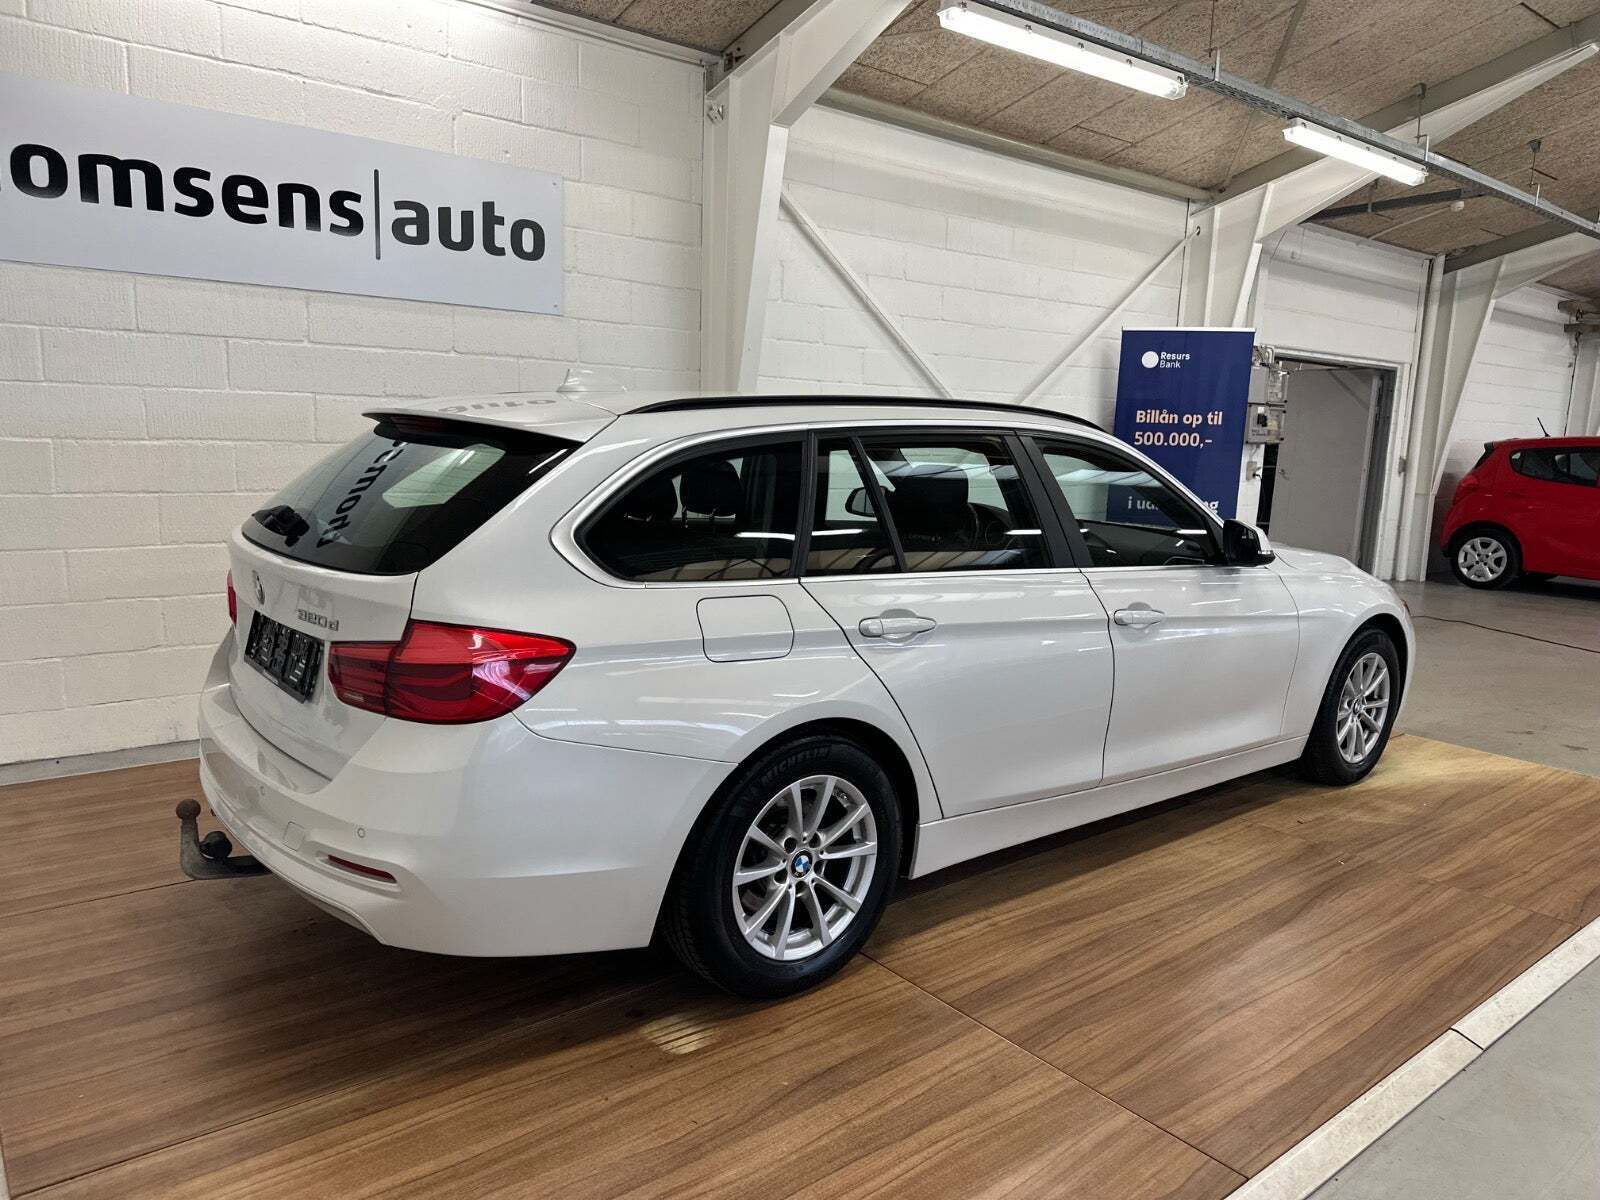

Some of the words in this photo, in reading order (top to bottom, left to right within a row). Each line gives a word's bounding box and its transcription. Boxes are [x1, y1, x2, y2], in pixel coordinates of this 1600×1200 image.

[0, 143, 364, 237] omsens
[391, 200, 546, 262] auto
[1160, 351, 1191, 360] Resurs
[1159, 360, 1181, 369] Bank
[1136, 409, 1179, 424] Billån
[1183, 413, 1202, 428] op
[1207, 411, 1223, 425] til
[1134, 432, 1213, 448] 500.000,-
